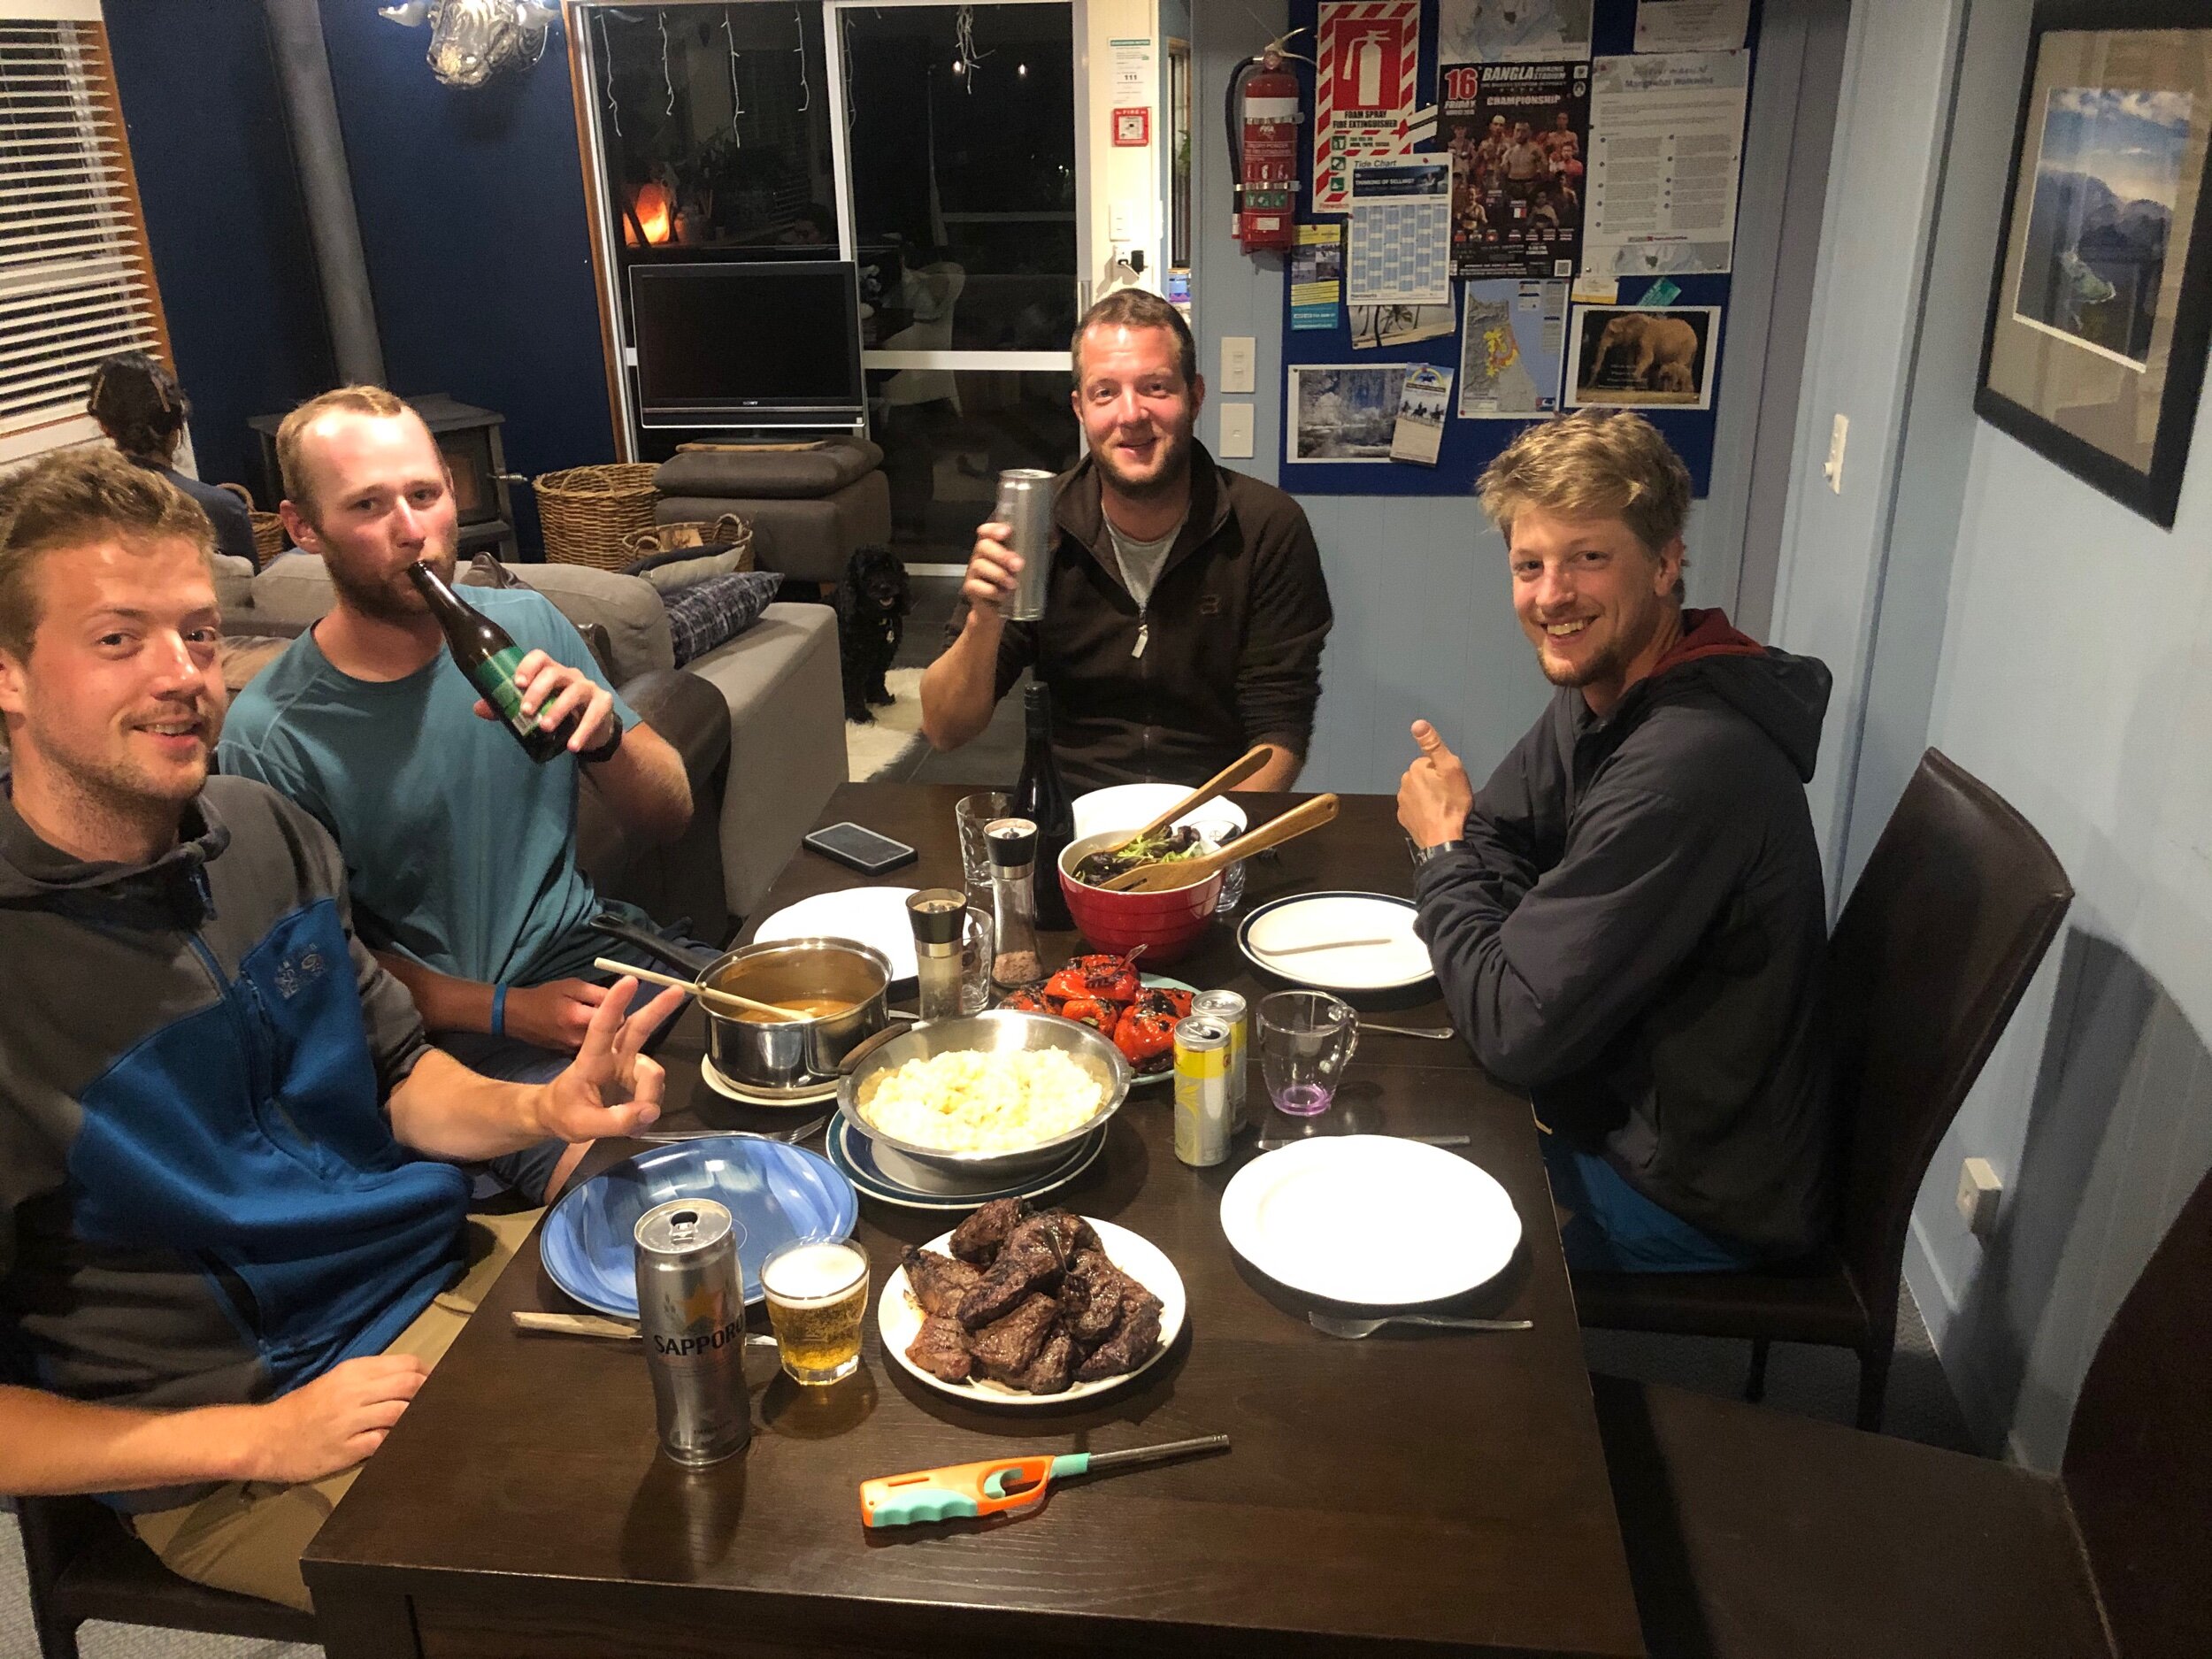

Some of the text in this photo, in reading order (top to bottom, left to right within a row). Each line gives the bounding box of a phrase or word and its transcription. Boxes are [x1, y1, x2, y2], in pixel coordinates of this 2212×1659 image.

[1482, 66, 1534, 81] BANGLA
[1445, 67, 1478, 100] 16
[1444, 100, 1477, 110] FRIDAY
[1486, 95, 1561, 106] CHAMPIONSHIP
[1365, 110, 1386, 119] SPRAY
[1333, 119, 1397, 128] FIRE EXTINGUISHER
[654, 1313, 743, 1356] SAPPORO
